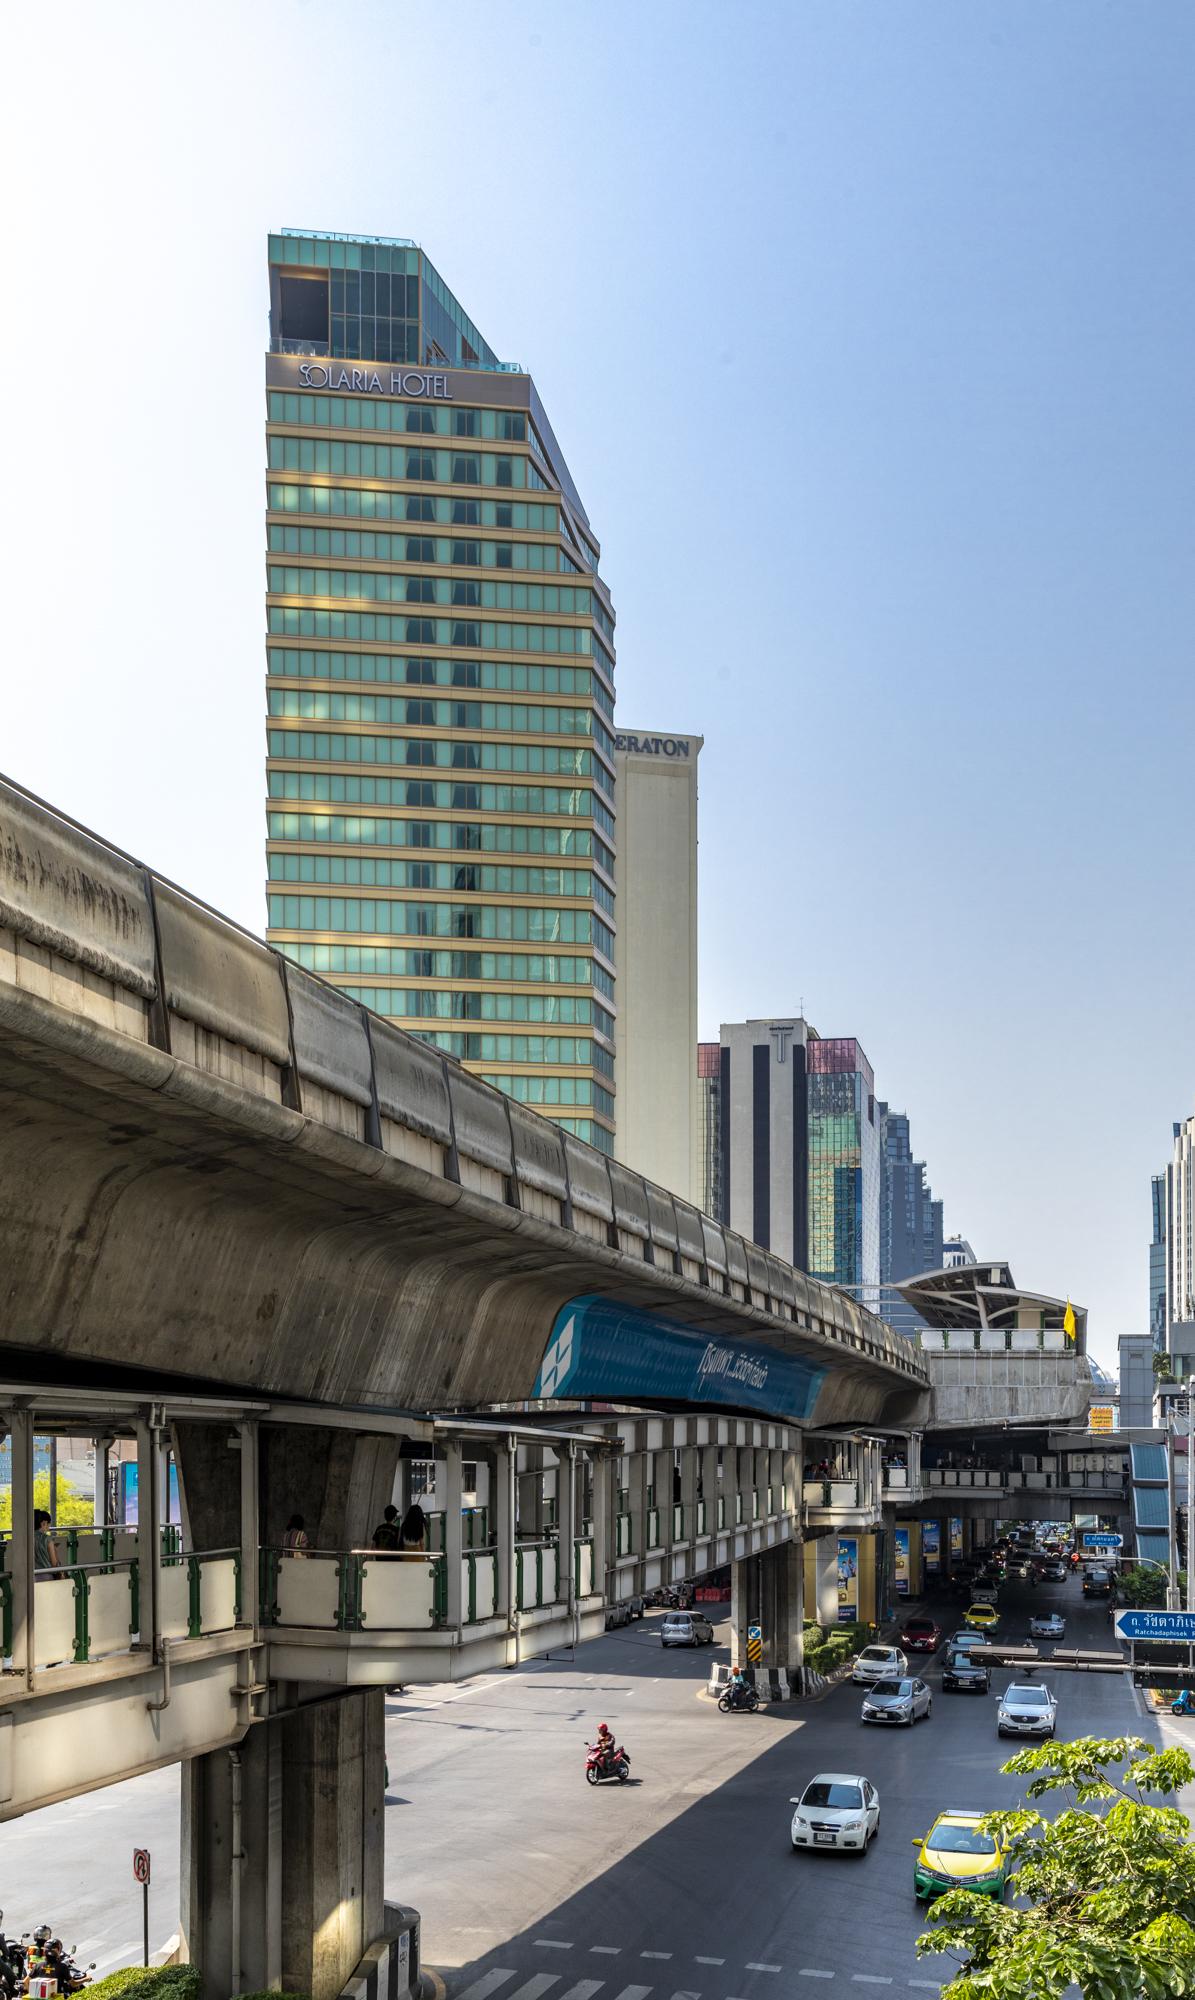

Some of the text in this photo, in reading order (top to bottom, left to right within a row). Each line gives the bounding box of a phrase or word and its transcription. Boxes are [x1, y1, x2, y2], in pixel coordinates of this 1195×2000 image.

[299, 363, 453, 399] SOLARIA HOTEL
[615, 734, 689, 757] ERATON
[1144, 1613, 1195, 1628] รัชดาภิเษ
[1134, 1628, 1188, 1637] Ratchadaphisek
